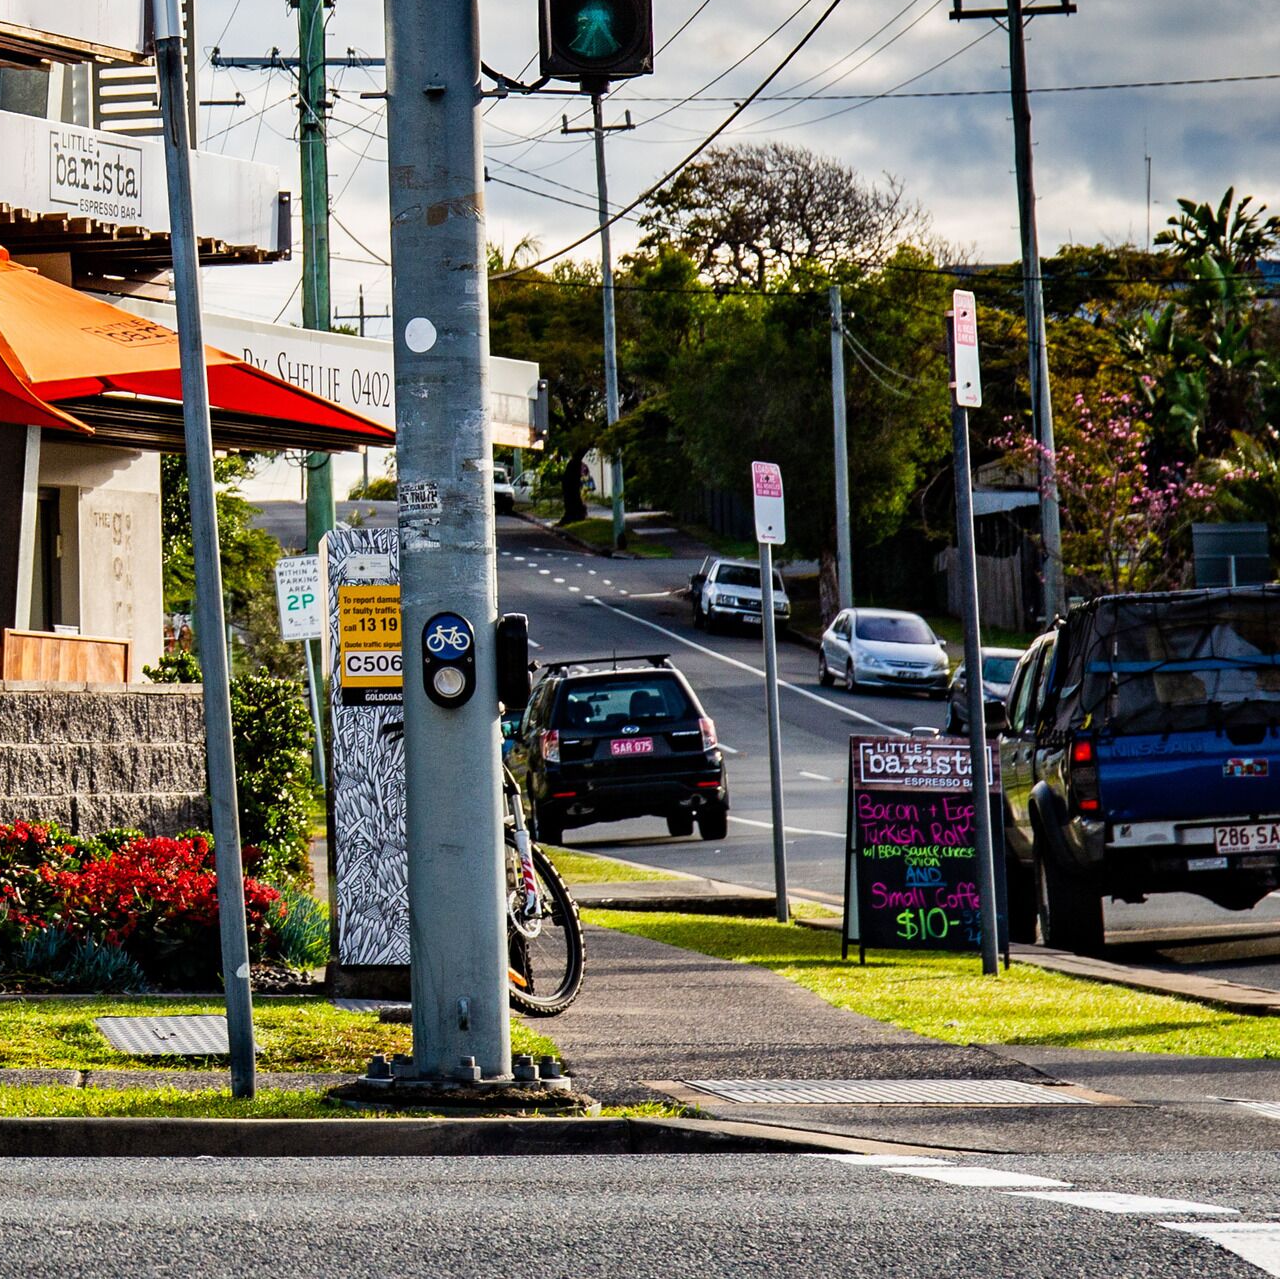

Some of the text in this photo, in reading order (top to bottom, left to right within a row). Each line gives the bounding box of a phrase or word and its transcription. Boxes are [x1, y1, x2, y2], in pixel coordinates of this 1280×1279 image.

[62, 133, 93, 153] LITTLE
[54, 142, 138, 199] barista
[80, 199, 136, 220] ESPRESSO BAR
[351, 369, 391, 408] 0402
[94, 512, 110, 528] THE
[278, 569, 308, 577] WITHIN
[279, 576, 319, 584] PARKING
[289, 585, 312, 593] AREA
[287, 593, 315, 611] 2P
[353, 596, 375, 605] report
[377, 596, 401, 605] damag
[353, 607, 373, 616] faulty
[375, 606, 397, 614] traffic
[359, 617, 376, 631] 13
[380, 617, 398, 631] 19
[347, 654, 403, 673] C506
[365, 693, 403, 701] GOLDCOAS
[613, 739, 653, 754] SAR 075
[877, 743, 922, 753] LITTLE
[1111, 740, 1206, 757] NISSAN
[904, 777, 960, 787] ESPRESSO
[857, 793, 919, 822] Bacon
[860, 822, 925, 845] Turkish
[906, 866, 942, 883] AND
[871, 882, 980, 910] Small Coffe
